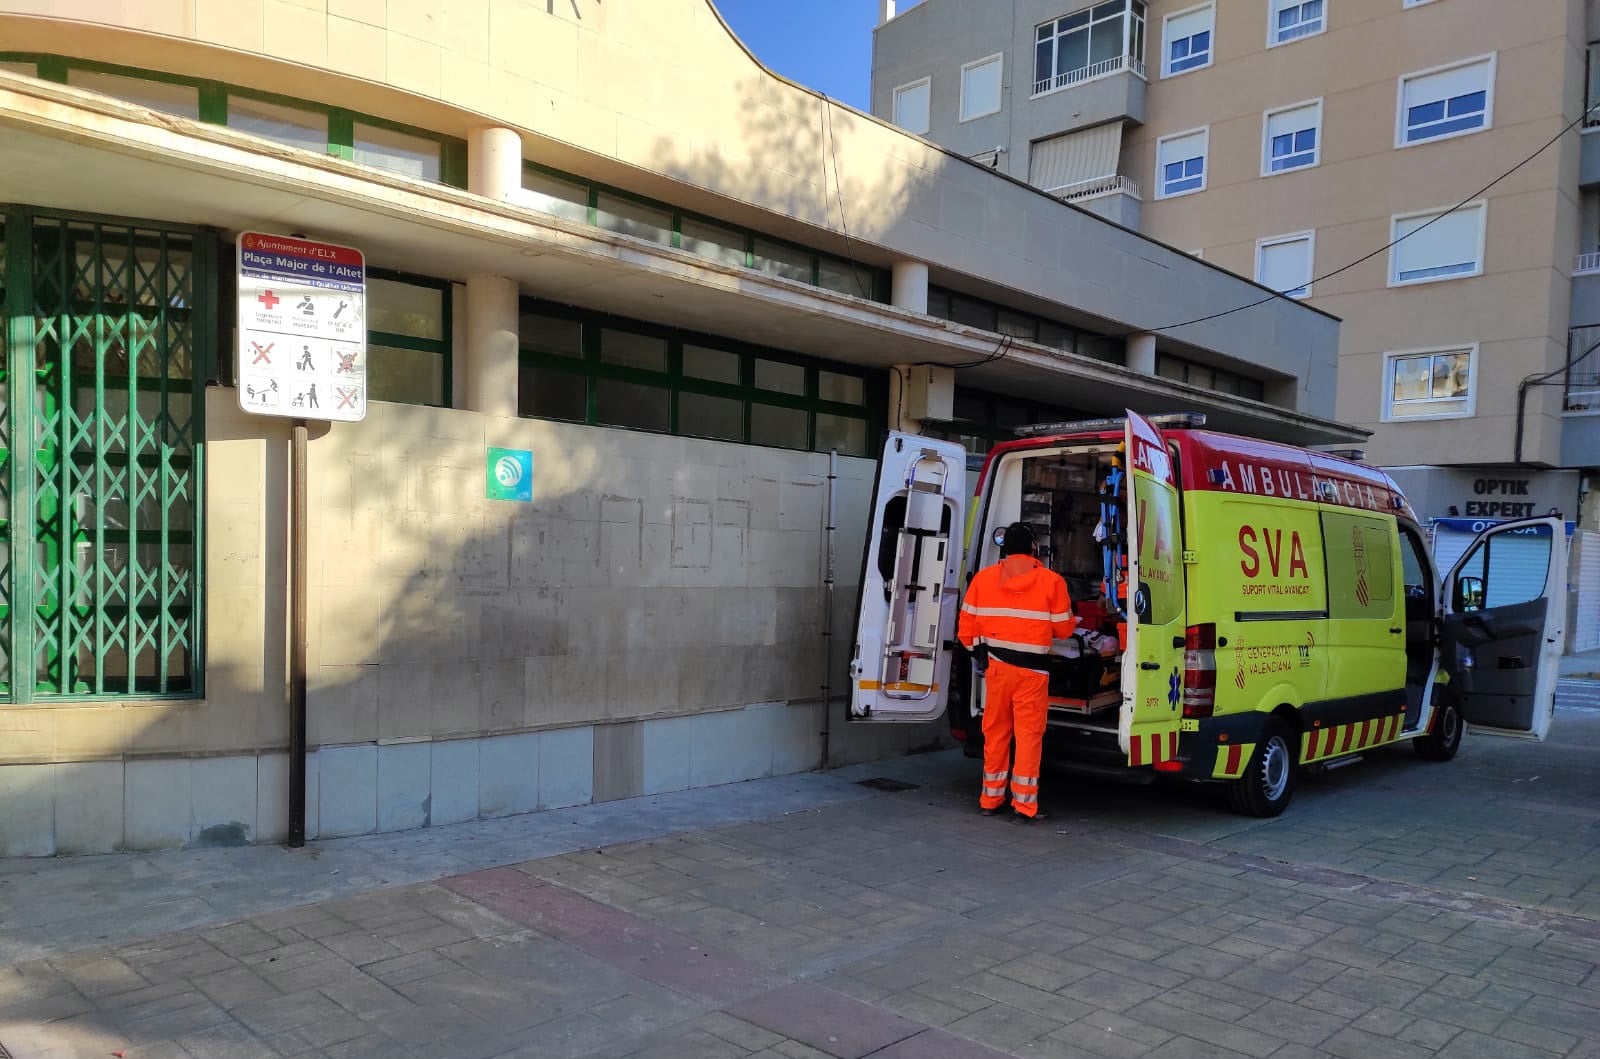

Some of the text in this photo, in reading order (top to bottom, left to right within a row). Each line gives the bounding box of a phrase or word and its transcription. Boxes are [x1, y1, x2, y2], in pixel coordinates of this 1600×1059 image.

[256, 239, 336, 259] Ajuntament d'ELX
[244, 252, 362, 278] Plaça Major de l'Altet
[1221, 460, 1377, 509] AMBULANCIA
[1473, 478, 1529, 495] OPTIK
[1465, 501, 1536, 517] EXPERT
[1238, 524, 1309, 579] SVA
[1242, 584, 1309, 595] SUPORT VITAL AVANCAT
[1247, 645, 1310, 659] GENERALITAT 112
[1249, 660, 1292, 675] VALENCIANA
